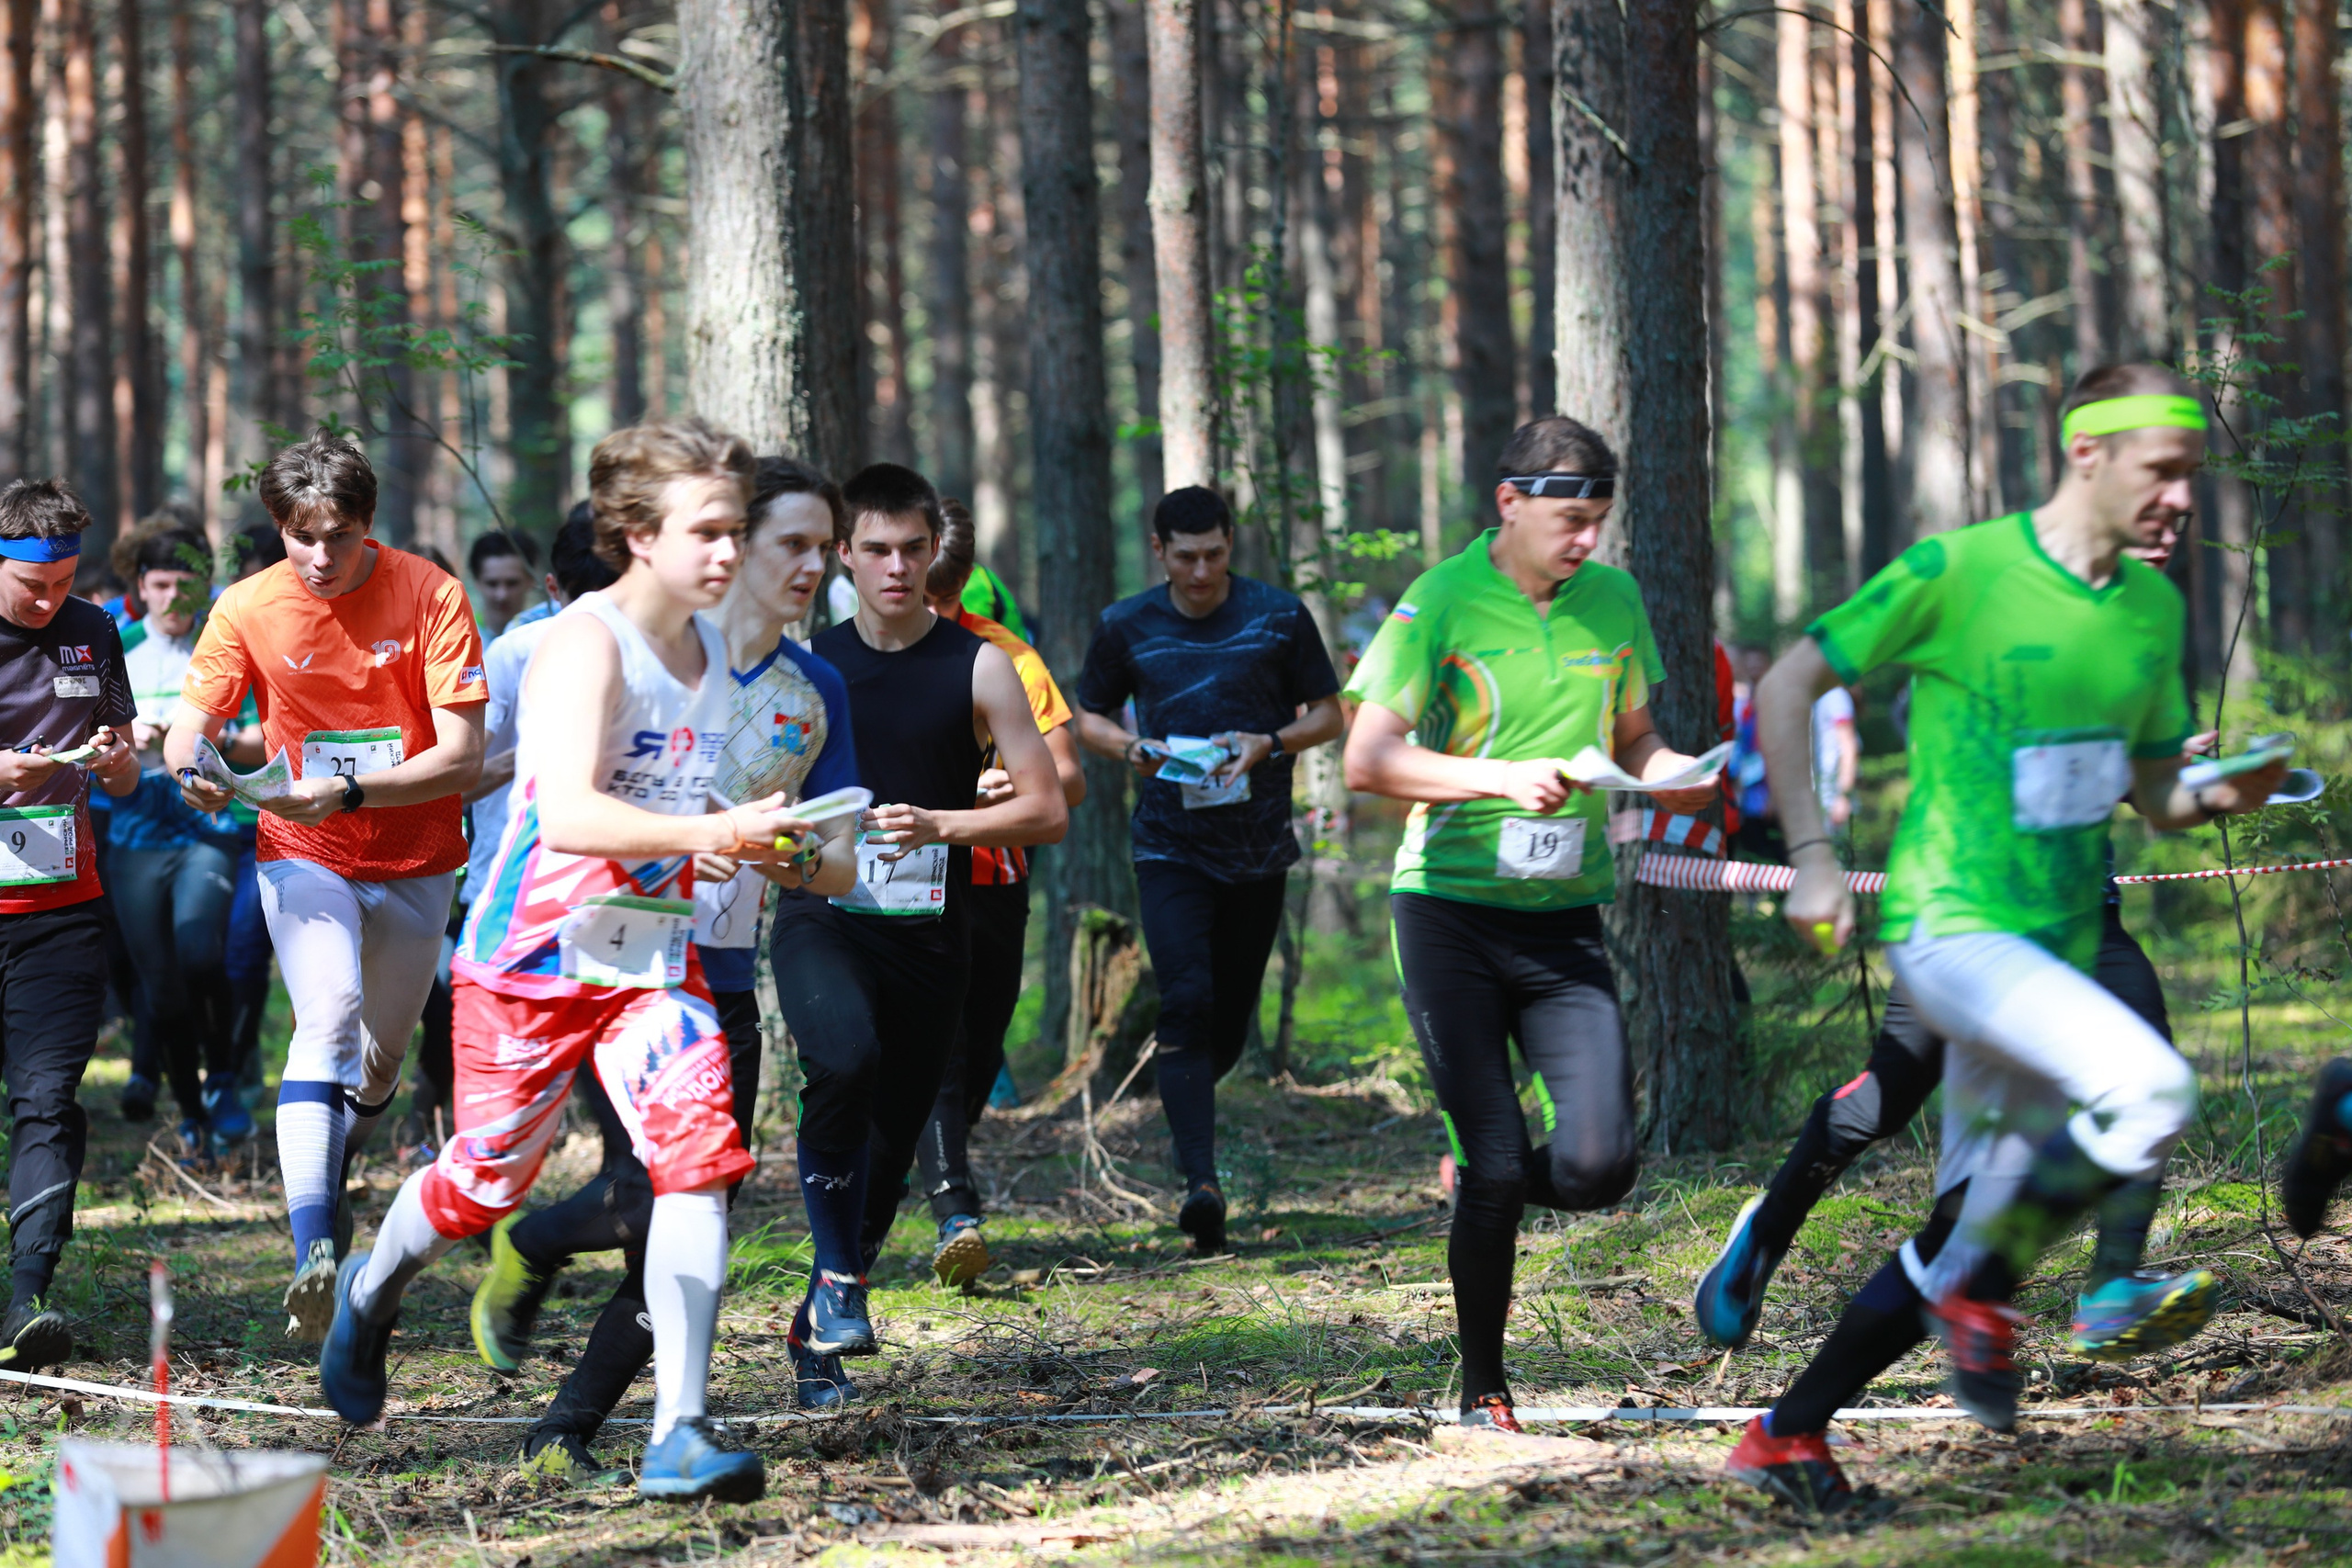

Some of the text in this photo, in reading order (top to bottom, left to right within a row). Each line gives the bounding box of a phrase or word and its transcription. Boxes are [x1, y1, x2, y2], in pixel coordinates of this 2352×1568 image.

[330, 756, 356, 777] 27
[11, 830, 27, 854] 9
[1526, 831, 1557, 862] 19
[866, 858, 898, 885] 17
[609, 923, 627, 951] 4
